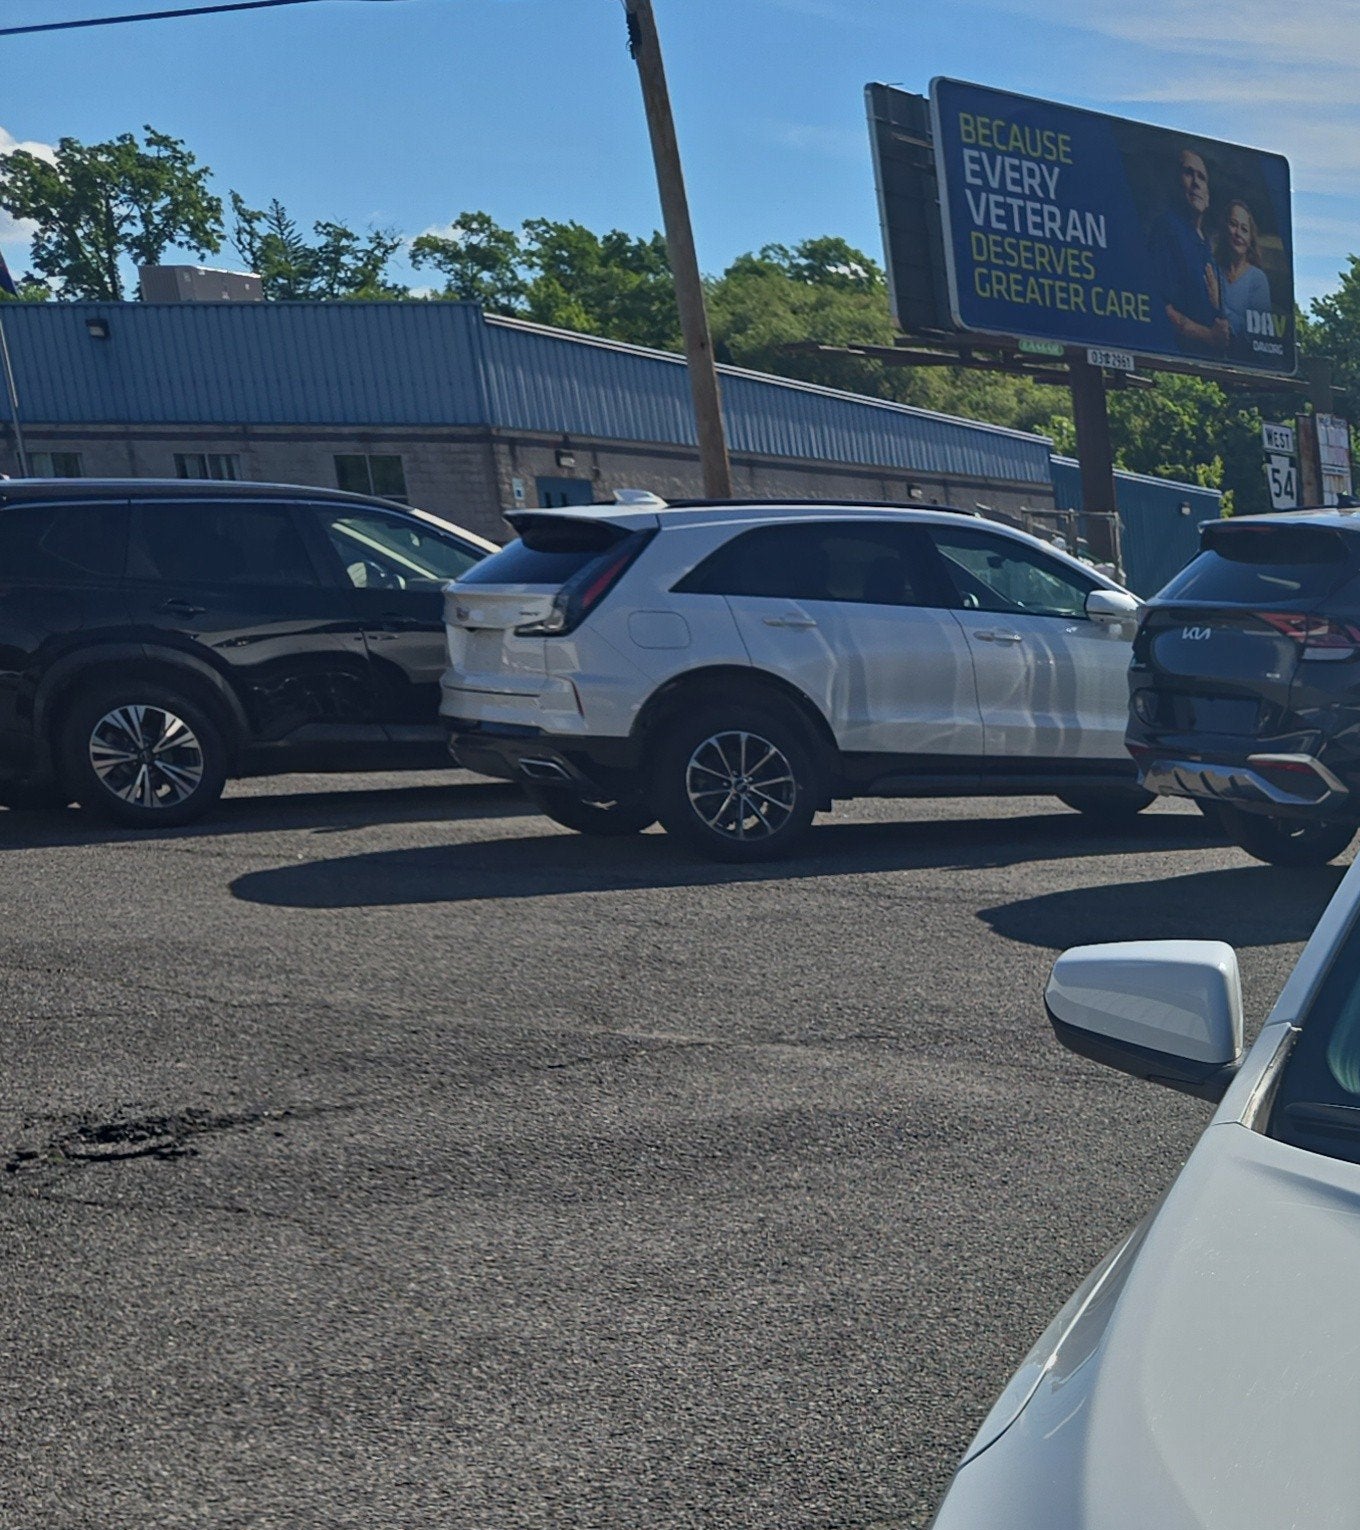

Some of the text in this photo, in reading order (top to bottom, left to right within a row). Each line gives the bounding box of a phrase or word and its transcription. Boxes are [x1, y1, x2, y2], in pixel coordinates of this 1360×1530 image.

[959, 112, 1073, 164] BECAUSE
[963, 148, 1060, 200] EVERY
[965, 189, 1107, 248] VETERAN
[971, 231, 1096, 280] DESERVES
[974, 267, 1151, 322] GREATER CARE
[1246, 309, 1286, 337] DAV
[1264, 427, 1290, 449] WEST
[1271, 467, 1295, 500] 54
[1182, 627, 1212, 640] KIA
